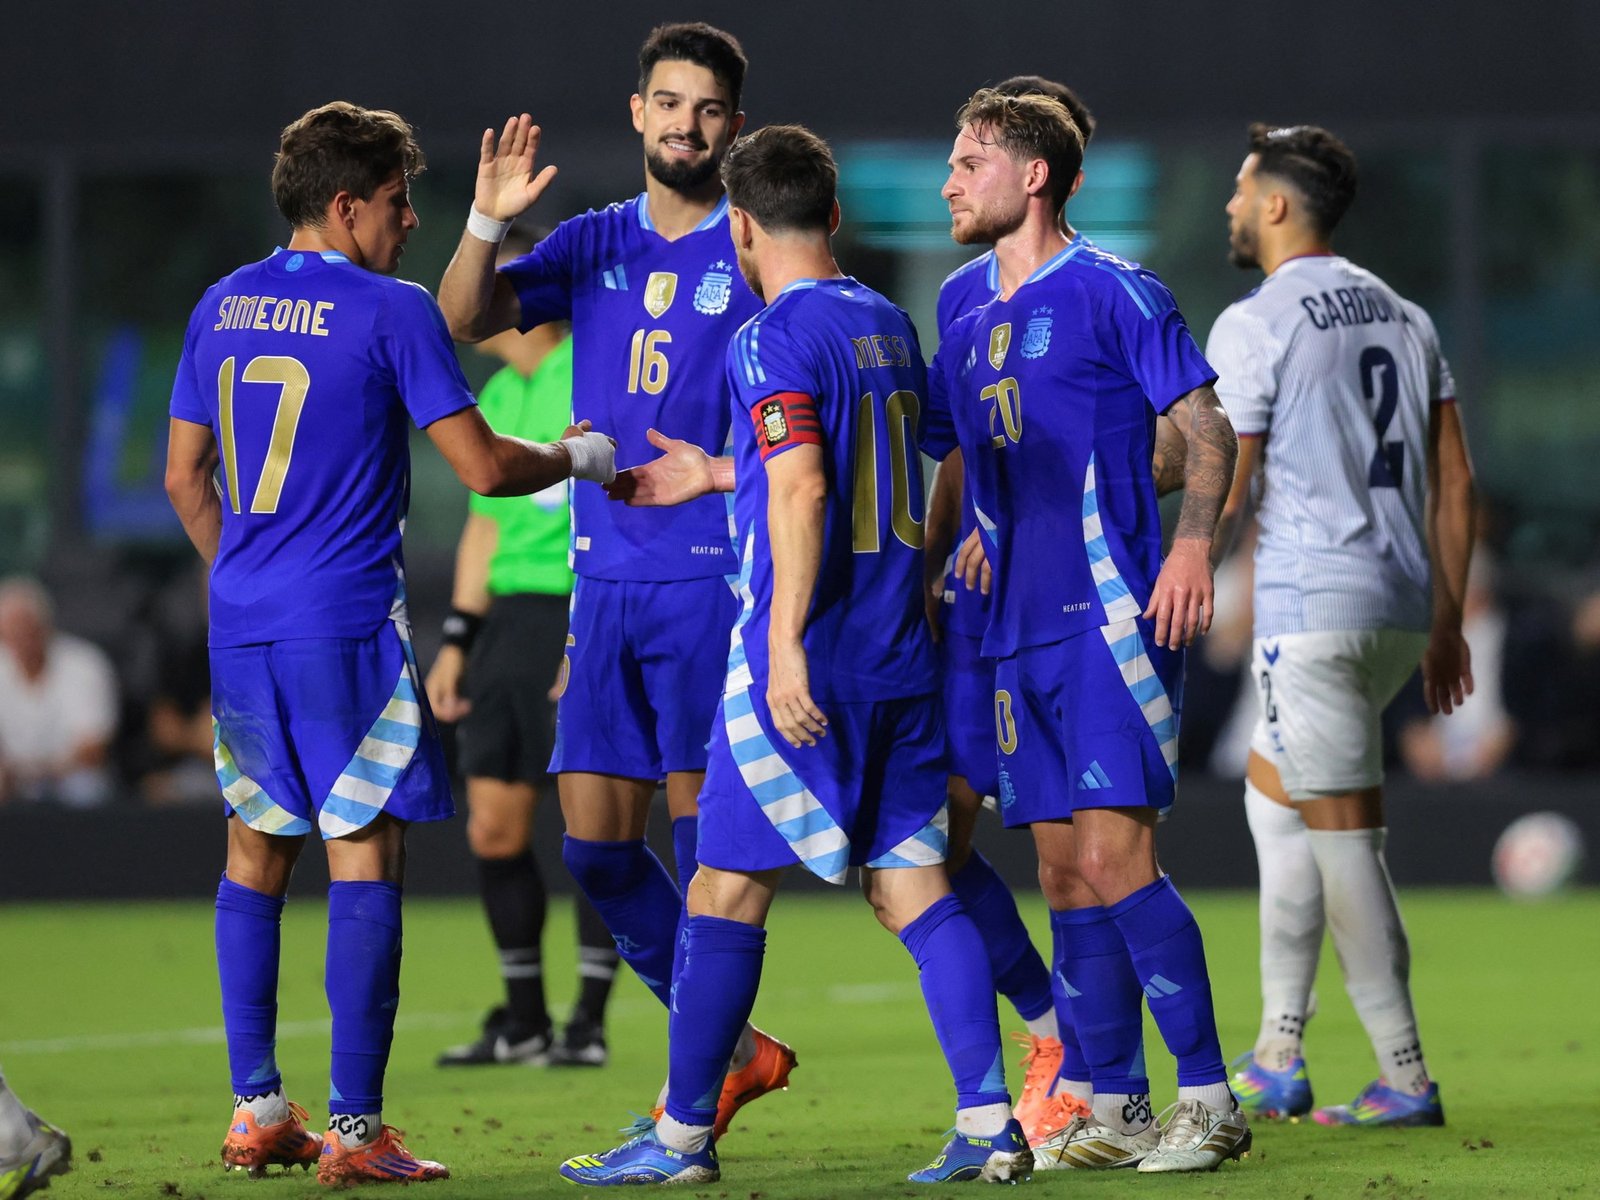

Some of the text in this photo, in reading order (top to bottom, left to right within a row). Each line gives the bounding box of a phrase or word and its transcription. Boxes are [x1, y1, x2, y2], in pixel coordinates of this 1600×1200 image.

[213, 295, 334, 337] SIMEONE
[627, 328, 673, 395] 16
[850, 335, 911, 369] MESSI
[218, 355, 311, 515] 17
[980, 376, 1023, 449] 20
[1358, 344, 1405, 489] 2
[852, 390, 925, 553] 10
[690, 545, 724, 556] HEAT.RDY
[1062, 601, 1091, 613] HEAT.RDY
